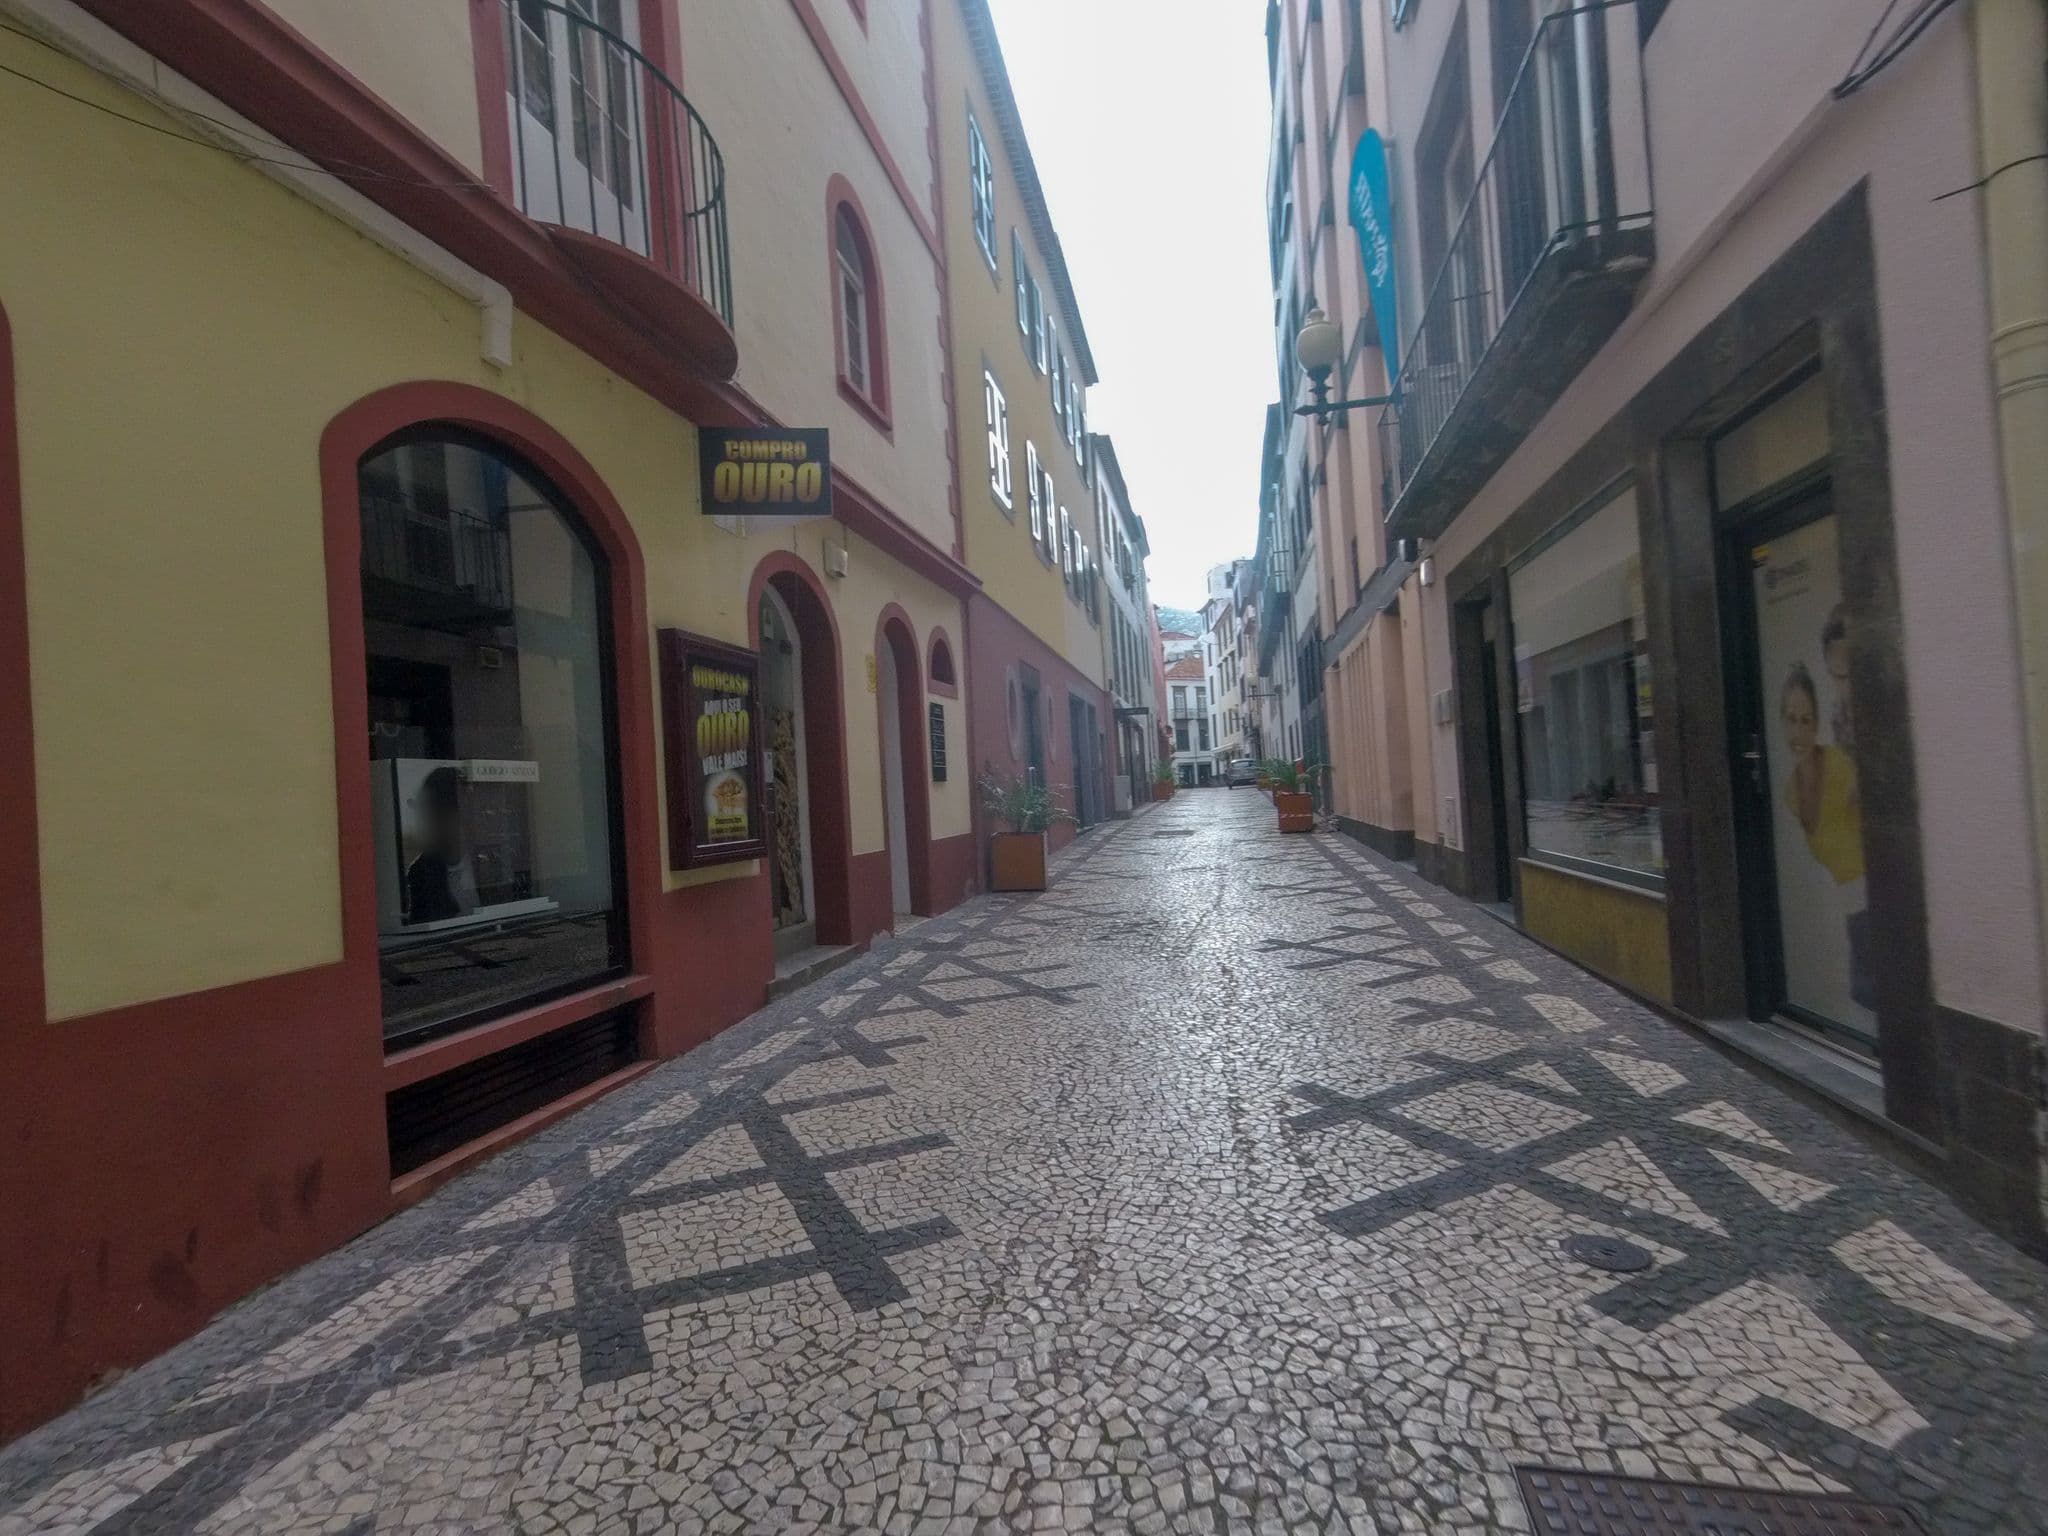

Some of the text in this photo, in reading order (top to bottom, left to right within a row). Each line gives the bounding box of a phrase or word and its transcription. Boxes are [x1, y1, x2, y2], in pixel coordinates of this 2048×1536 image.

[724, 440, 807, 459] COMPRO
[714, 461, 821, 502] OURO
[696, 710, 750, 757] OURO
[702, 754, 723, 776] VALE
